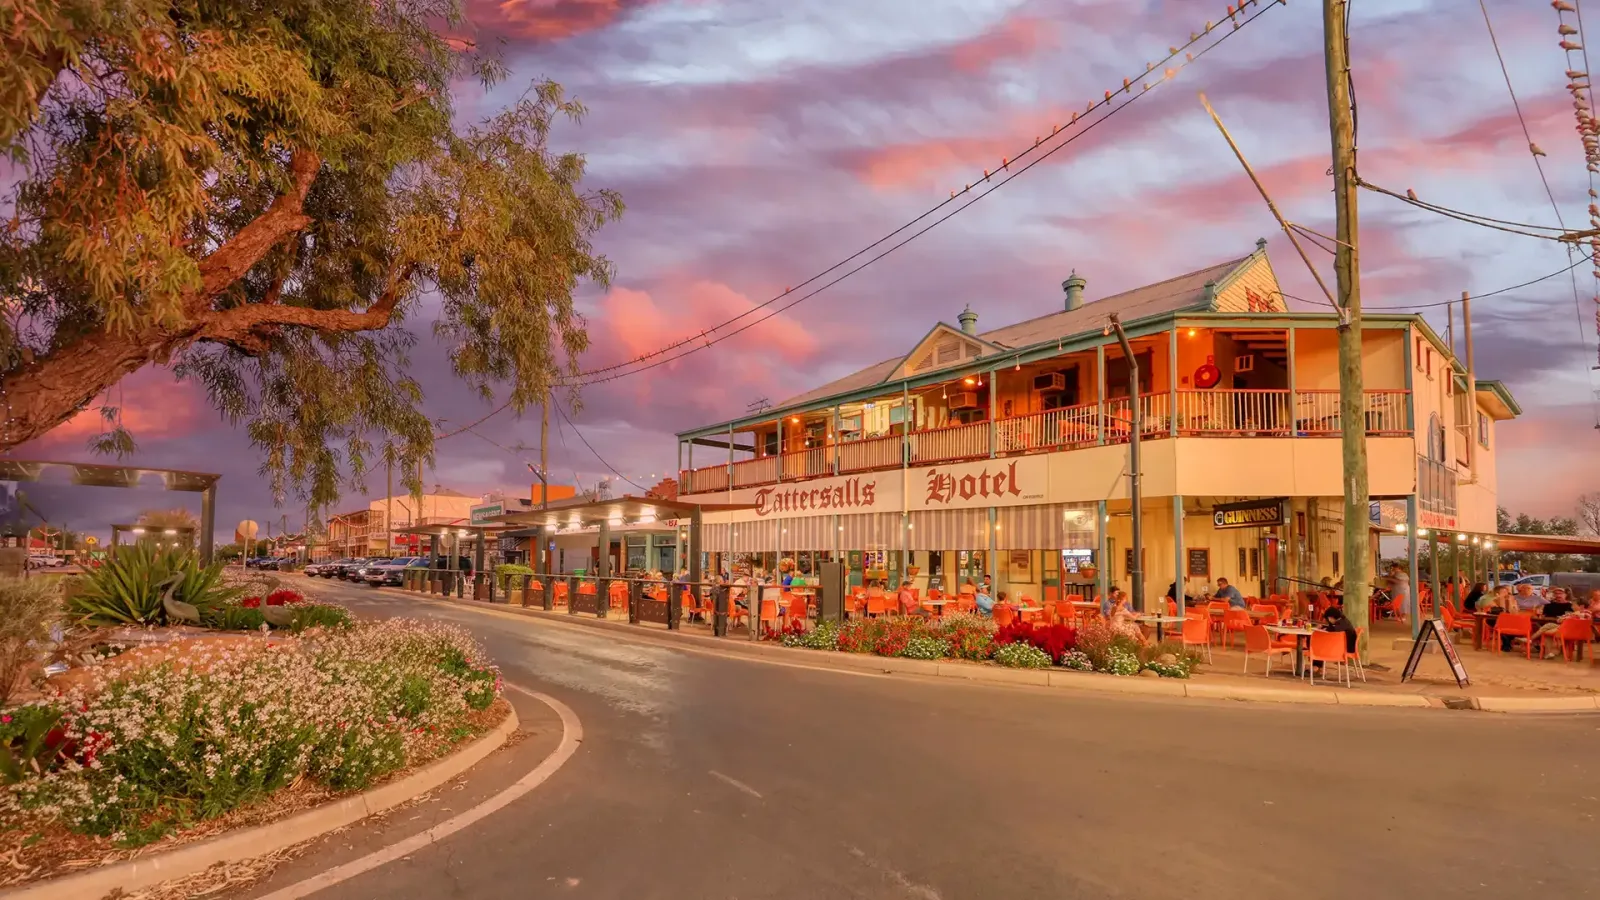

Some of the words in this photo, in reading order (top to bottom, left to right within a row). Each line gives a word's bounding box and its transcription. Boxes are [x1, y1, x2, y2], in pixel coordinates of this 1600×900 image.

[755, 477, 876, 516] Tattersalls
[926, 460, 1022, 505] Hotel
[1224, 506, 1278, 524] GUINNESS
